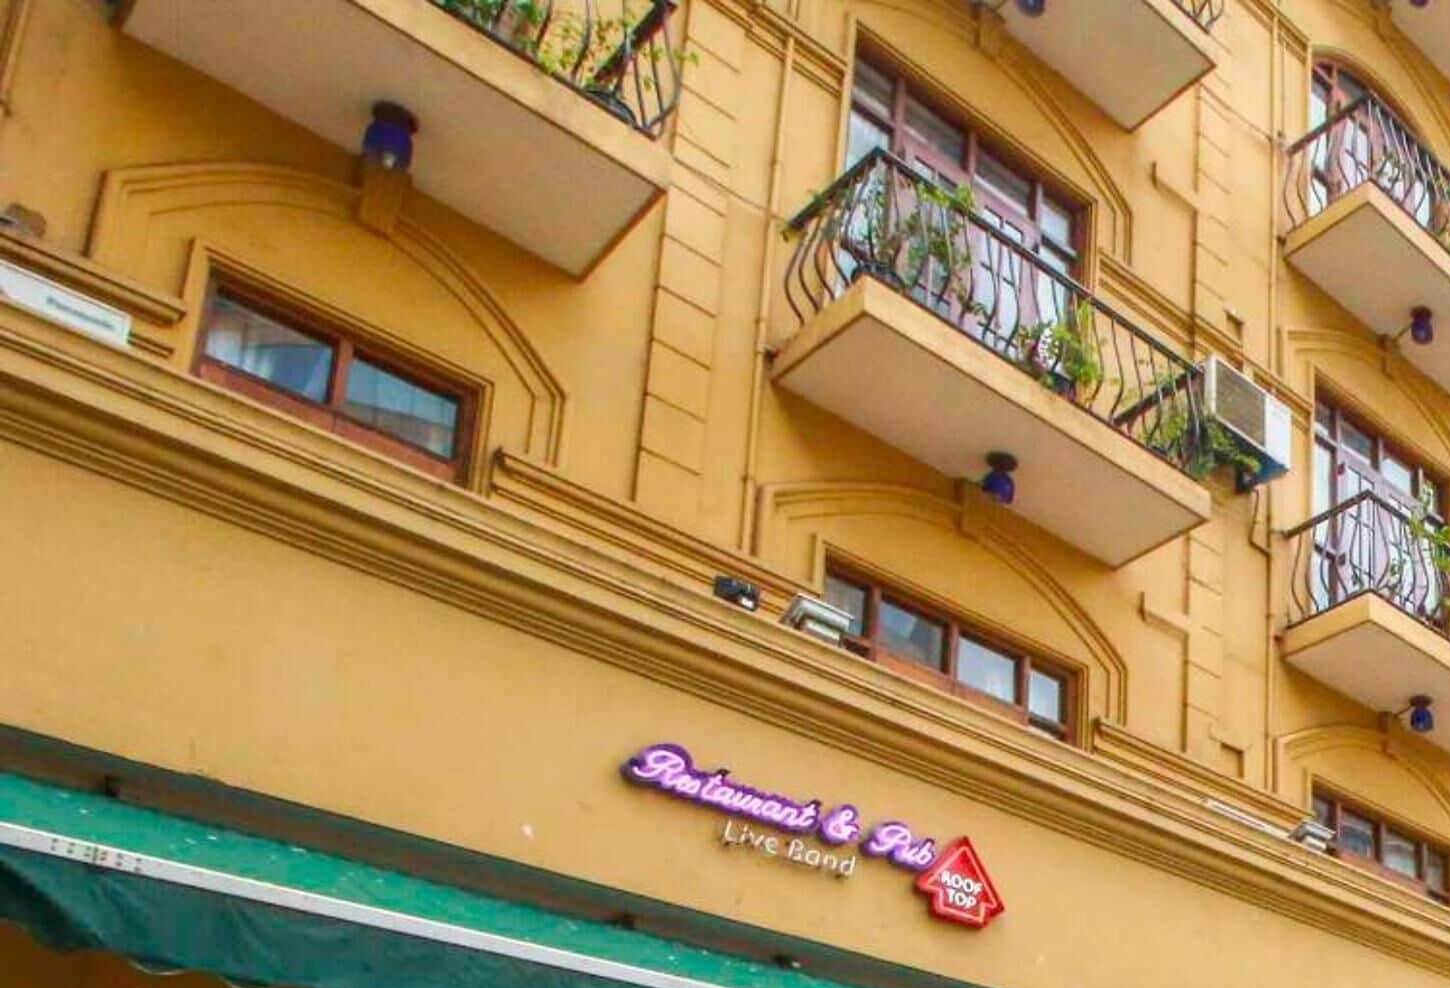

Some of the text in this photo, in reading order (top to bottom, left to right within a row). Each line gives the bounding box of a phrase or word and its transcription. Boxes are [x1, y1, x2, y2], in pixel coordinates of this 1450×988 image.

[627, 747, 936, 867] Restaurant & Pub
[722, 820, 857, 877] Live Band
[940, 869, 984, 896] ROOF
[947, 887, 978, 910] TOP
